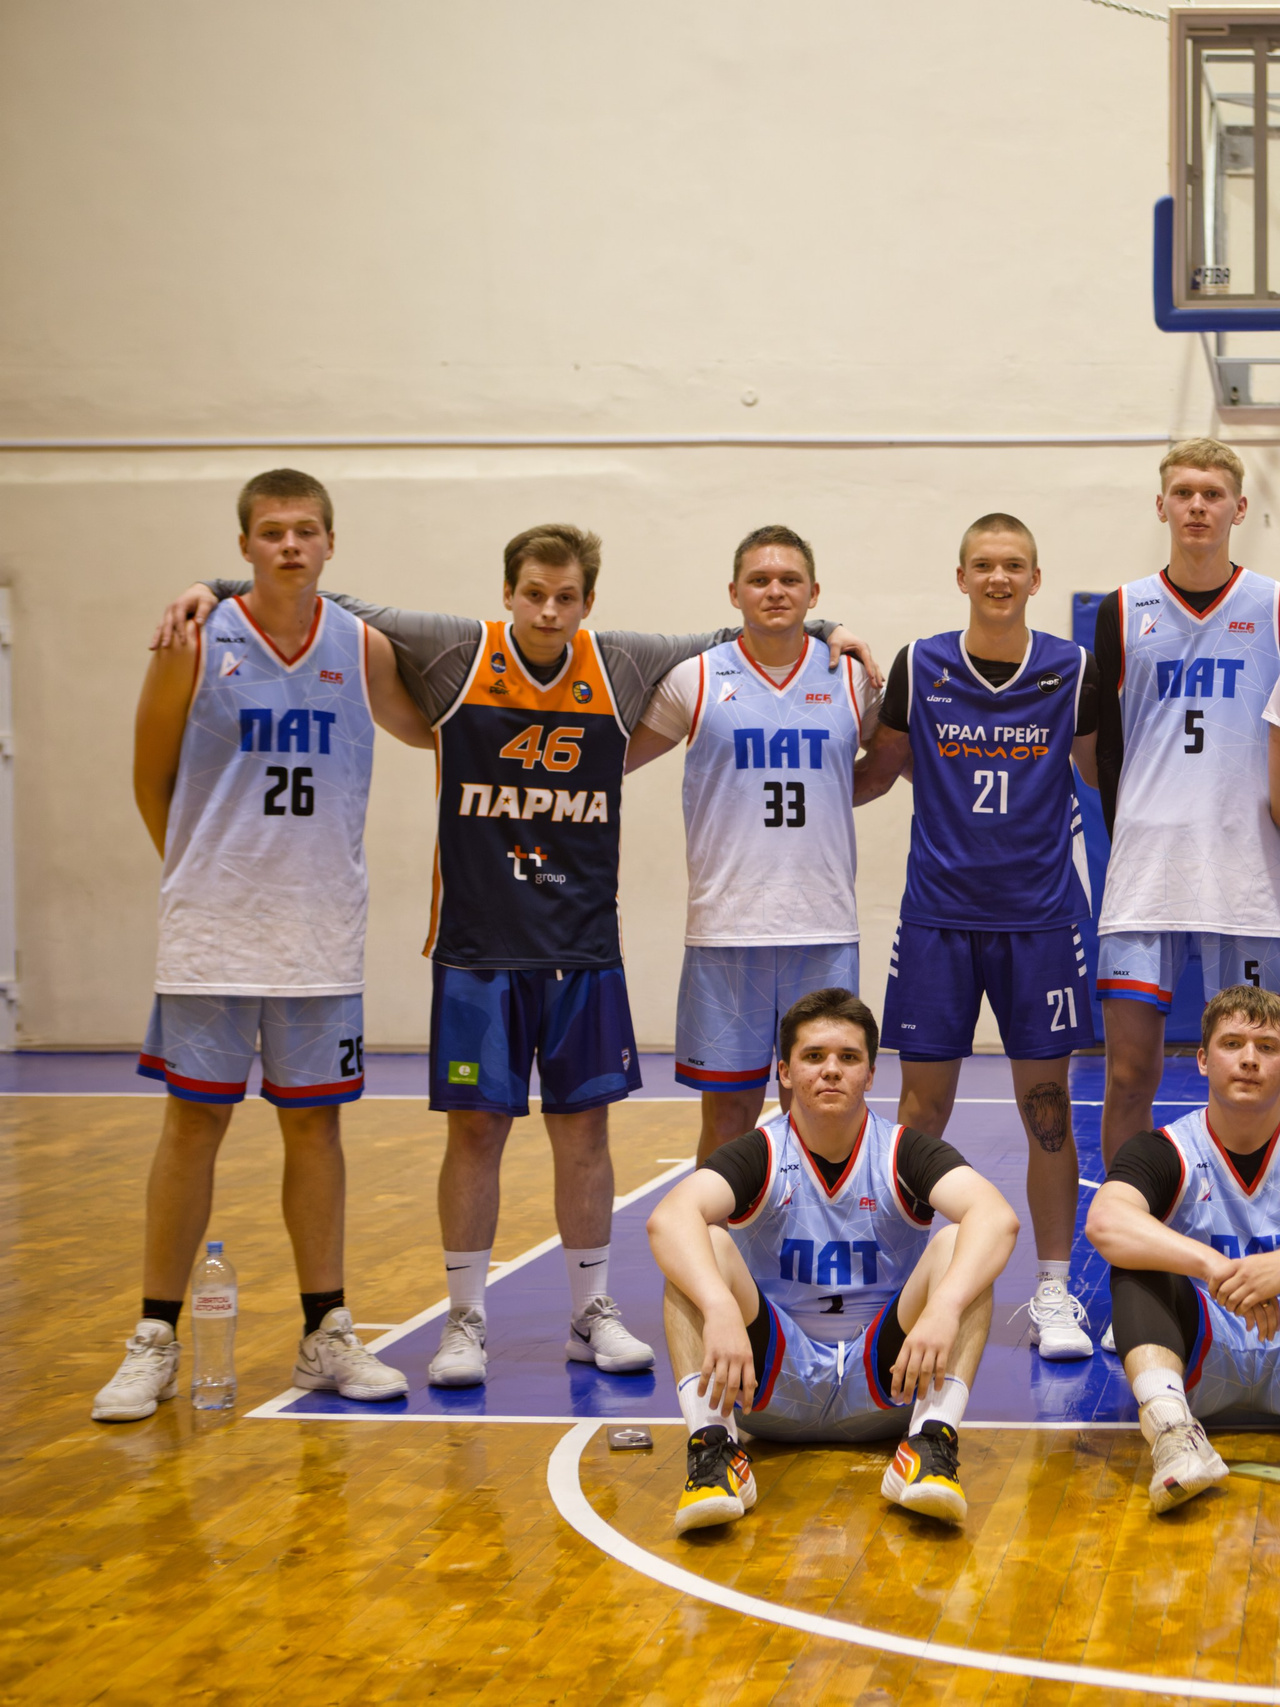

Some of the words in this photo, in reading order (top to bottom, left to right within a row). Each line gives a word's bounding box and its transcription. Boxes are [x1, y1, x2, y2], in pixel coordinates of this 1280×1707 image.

[1136, 599, 1160, 607] MAXX
[1156, 657, 1245, 701] ПАТ
[239, 708, 336, 754] ПАТ
[499, 724, 585, 773] 46
[733, 728, 830, 770] ПАТ
[935, 723, 987, 741] УРАЛ
[993, 724, 1050, 744] ГРЕЙТ
[937, 741, 1049, 761] ЮНИОР
[1184, 709, 1204, 754] 5
[264, 766, 314, 817] 26
[458, 783, 609, 823] ПАРМА
[763, 781, 806, 828] 33
[972, 769, 1009, 814] 21
[535, 873, 567, 885] group
[1244, 960, 1260, 987] 5
[1046, 986, 1079, 1032] 21
[780, 1164, 800, 1174] MXX
[779, 1238, 882, 1286] ПАТ
